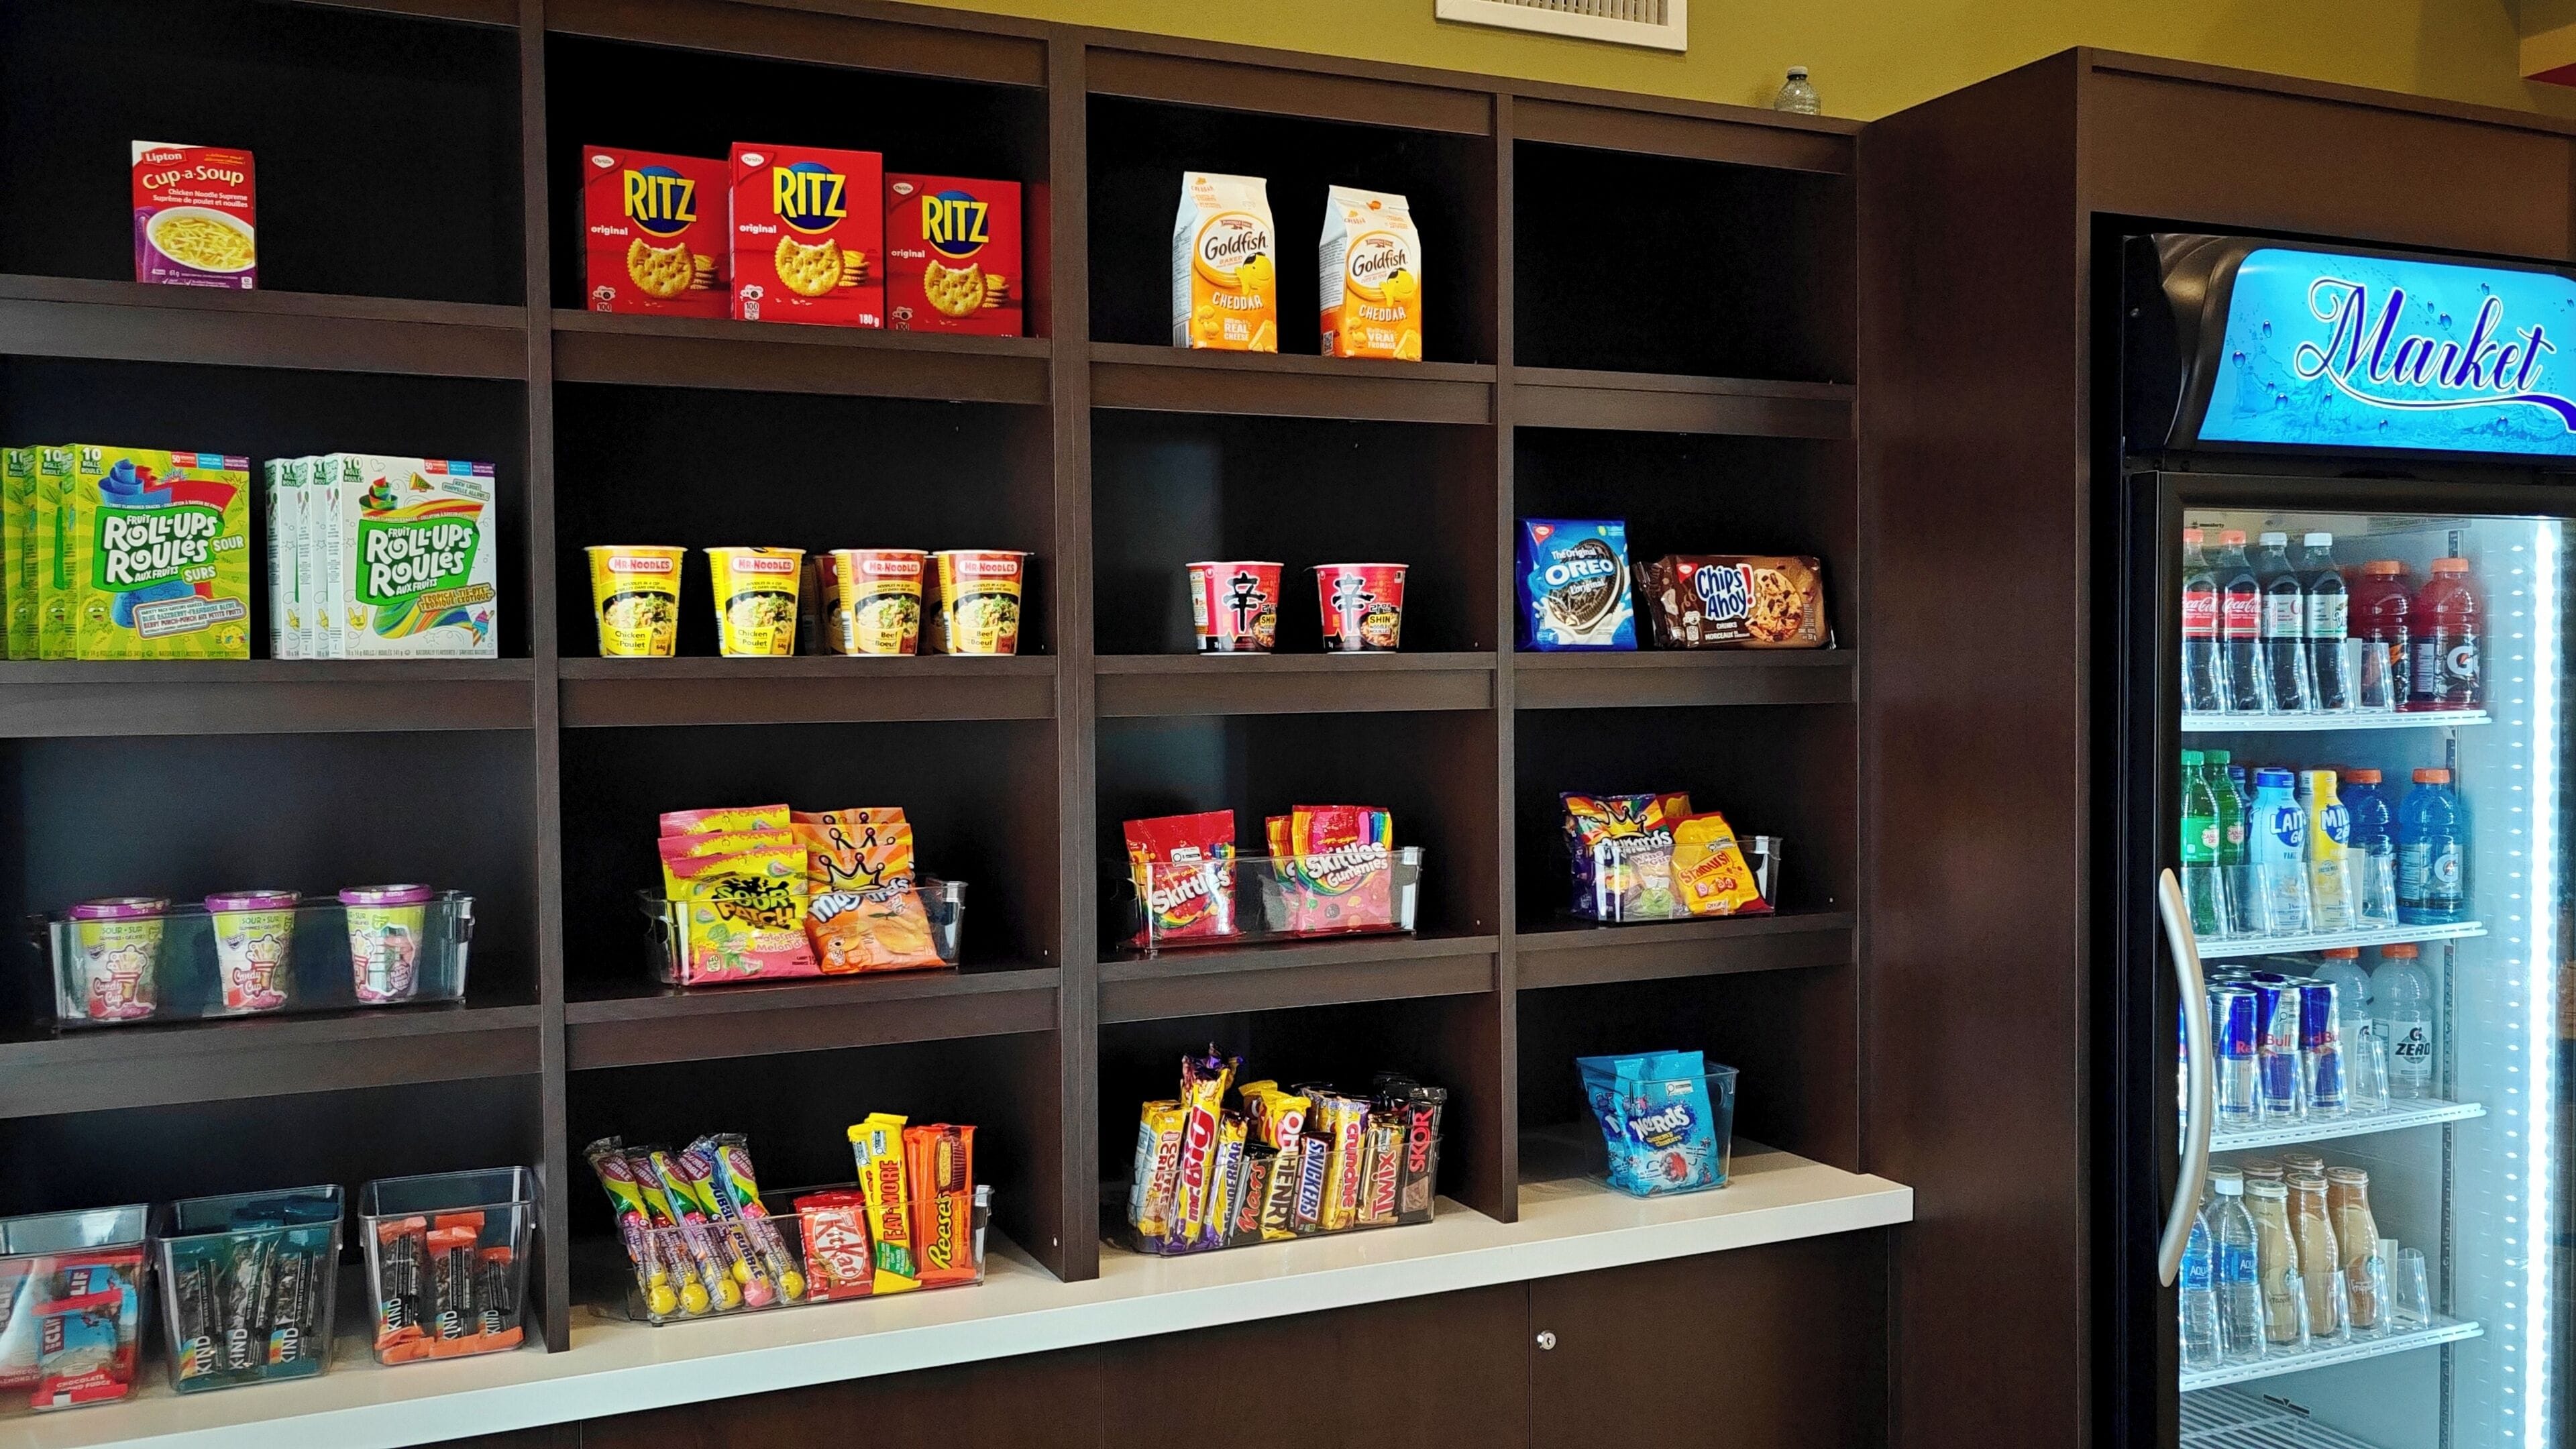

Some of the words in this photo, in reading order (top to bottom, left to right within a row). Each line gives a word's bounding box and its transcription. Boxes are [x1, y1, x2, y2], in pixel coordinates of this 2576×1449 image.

[146, 153, 182, 163] Lipton
[219, 193, 247, 201] Supreme
[624, 170, 696, 222] RITZ
[773, 166, 847, 217] RITZ
[193, 197, 214, 205] poulet
[223, 200, 248, 208] nouilles
[922, 195, 989, 243] RITZ
[591, 225, 628, 235] original
[739, 224, 777, 234] original
[891, 250, 925, 258] original
[1205, 231, 1267, 260] Goldfish
[1352, 249, 1406, 277] Goldfish
[1212, 292, 1263, 311] CHEDDAR
[859, 314, 873, 324] 180
[1359, 304, 1406, 322] CHEDDAR
[1224, 323, 1248, 333] REAL
[1367, 332, 1393, 341] VRAI
[2295, 275, 2559, 406] Market
[83, 447, 102, 461] 10
[343, 458, 363, 470] 10
[127, 515, 151, 525] FRUIT
[104, 513, 218, 551] ROLL-UPS
[388, 527, 411, 538] FRUIT
[213, 535, 244, 552] SOUR
[367, 524, 474, 564] ROLL-UPS
[1552, 551, 1566, 559] The
[1566, 547, 1597, 559] Original
[630, 559, 669, 569] NOODLES
[753, 560, 791, 569] NOODLES
[885, 563, 918, 572] NOODLES
[979, 563, 1014, 572] NOODLES
[1545, 559, 1614, 586] OREO
[134, 572, 152, 583] AUX
[152, 566, 179, 580] FRUITS
[184, 566, 217, 582] SURS
[1697, 565, 1743, 598] Chips
[396, 583, 413, 596] AUX
[413, 578, 437, 593] FRUITS
[1223, 572, 1266, 632] 辛
[1333, 574, 1375, 631] 辛
[2320, 808, 2350, 831] MIL
[2290, 830, 2304, 843] GO
[1306, 841, 1387, 879] Skittles
[1326, 858, 1387, 888] Gummies
[716, 886, 789, 910] SOUR
[1152, 870, 1230, 914] Skittls
[241, 916, 262, 924] SOUR
[716, 902, 794, 925] PATCH
[102, 926, 123, 934] SOUR
[757, 943, 791, 951] Melon
[94, 979, 122, 991] Candy
[234, 969, 261, 983] Candy
[245, 982, 262, 994] Cup
[105, 992, 123, 1004] Cup
[2265, 1033, 2291, 1046] Bull
[2395, 1042, 2430, 1057] ZERO
[1281, 1111, 1305, 1152] OH
[1409, 1108, 1434, 1173] SKOR
[684, 1151, 710, 1172] DUBBLE
[1154, 1142, 1170, 1192] CRISP
[1300, 1140, 1324, 1218] SNICKERS
[1236, 1159, 1266, 1233] Mars
[733, 1232, 765, 1280] BUBBLE
[70, 1273, 89, 1295] LIF
[387, 1297, 402, 1332] KIND
[485, 1309, 500, 1336] KIND
[443, 1310, 458, 1340] KIND
[229, 1328, 248, 1370] KIND
[280, 1327, 299, 1363] KIND
[196, 1335, 213, 1375] KIND
[56, 1374, 105, 1388] CHOCOLATE
